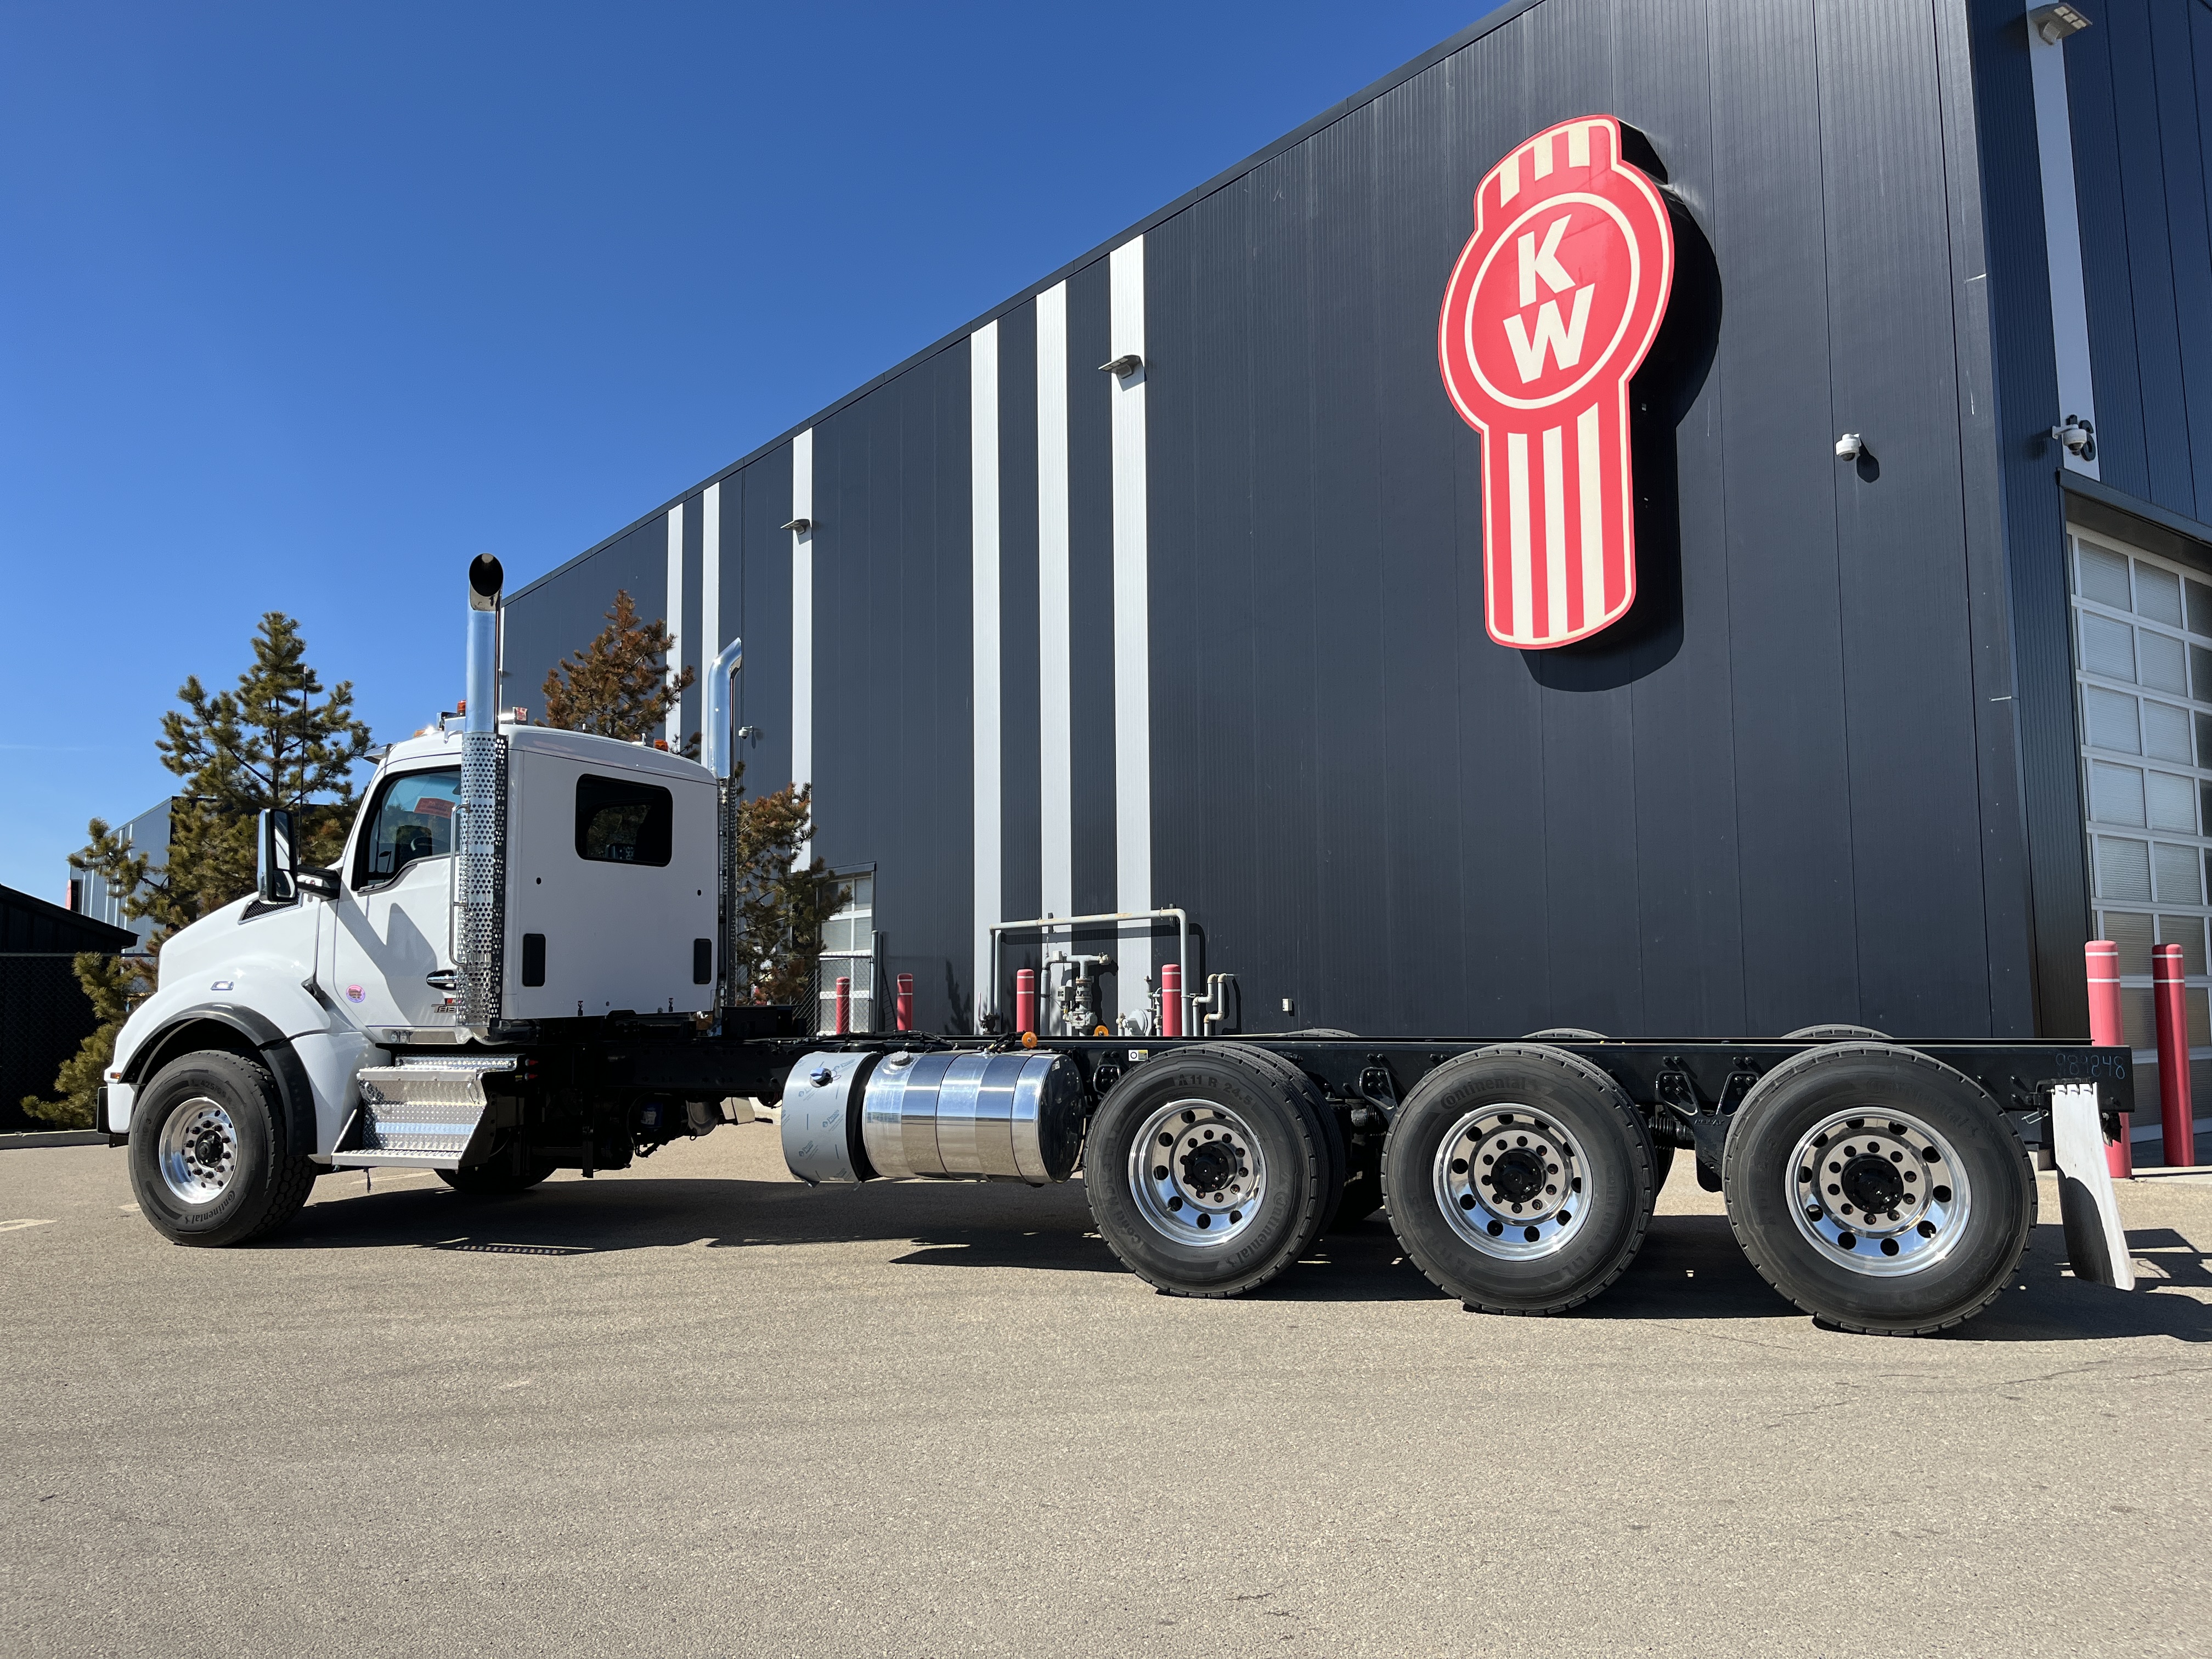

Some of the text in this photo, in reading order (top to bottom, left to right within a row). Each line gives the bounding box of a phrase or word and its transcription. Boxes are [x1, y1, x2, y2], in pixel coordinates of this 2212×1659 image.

[431, 1005, 457, 1013] T88
[1209, 1076, 1217, 1088] R
[1223, 1082, 1252, 1105] 24.5
[1441, 1077, 1526, 1110] Continental
[1606, 1163, 1619, 1208] Conti
[192, 1190, 236, 1223] Continental
[1113, 1210, 1142, 1246] Conti
[1237, 1192, 1290, 1266] Continental
